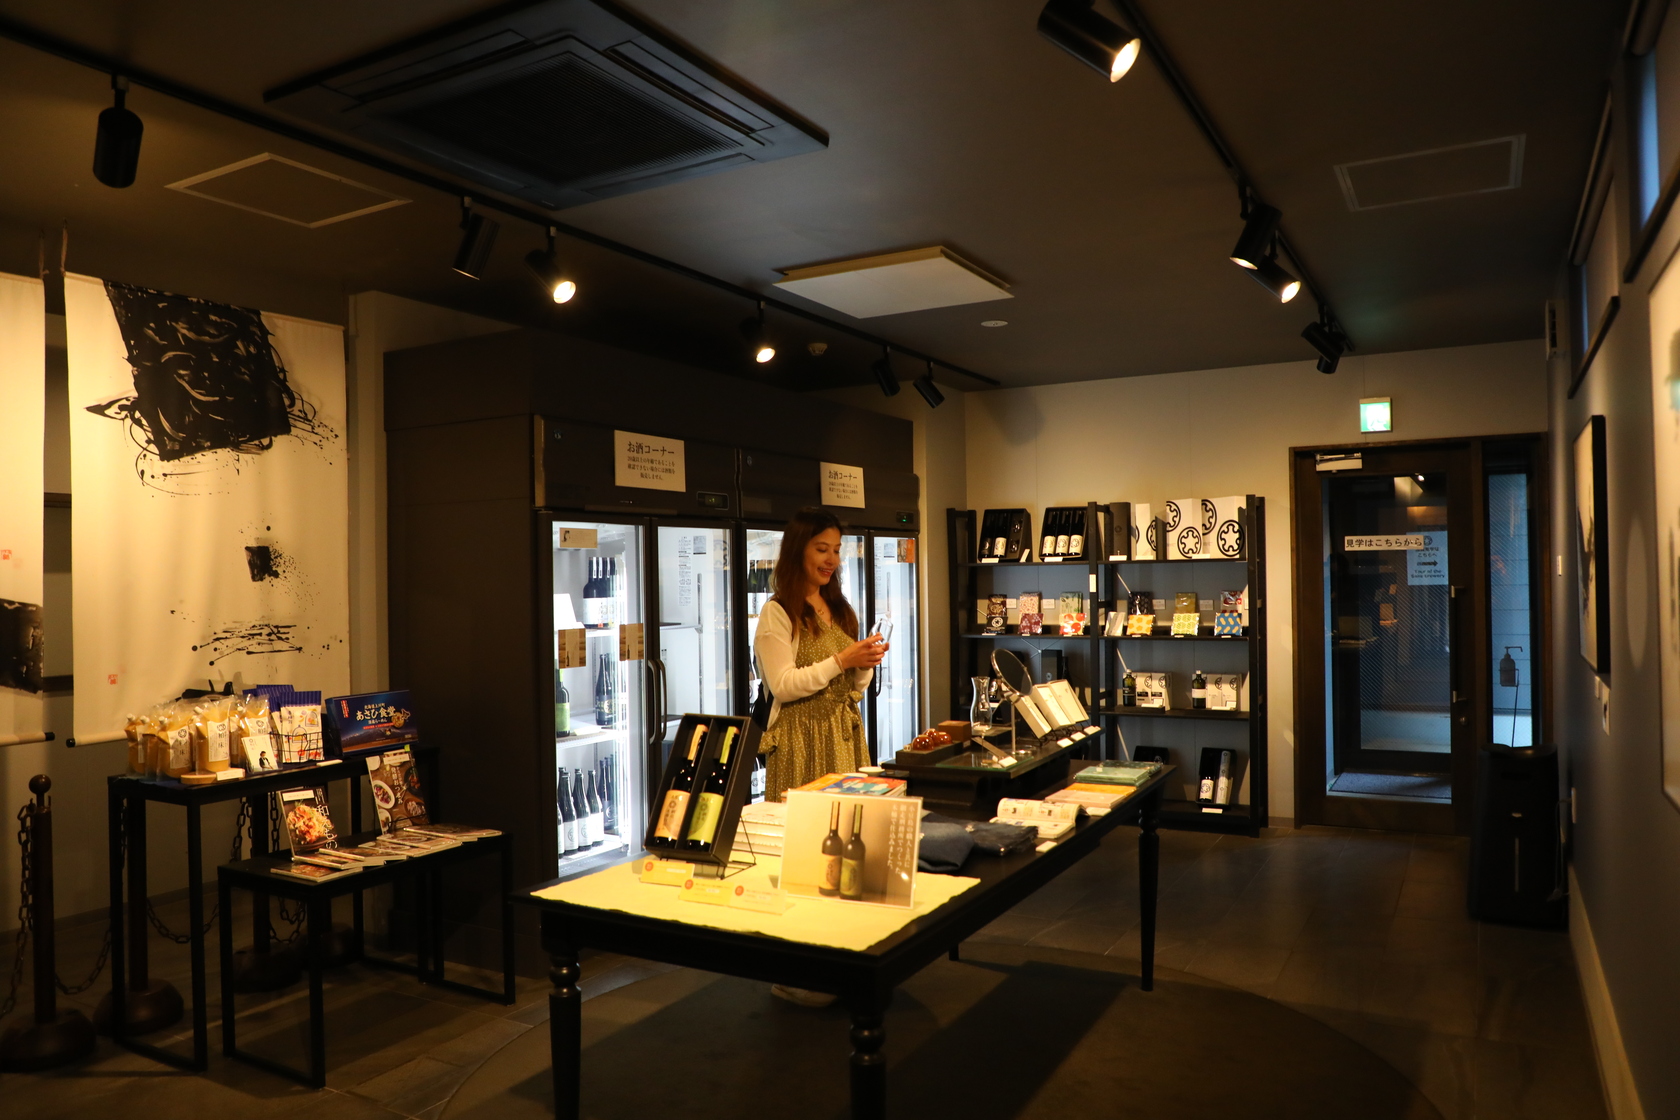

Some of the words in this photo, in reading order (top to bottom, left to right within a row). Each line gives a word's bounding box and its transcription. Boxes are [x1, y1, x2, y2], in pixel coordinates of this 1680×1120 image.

[627, 441, 675, 457] お酒コーナー
[828, 470, 858, 481] お酒コーナー
[1346, 538, 1423, 548] 見学はこちらから
[356, 705, 396, 721] あさひ食堂
